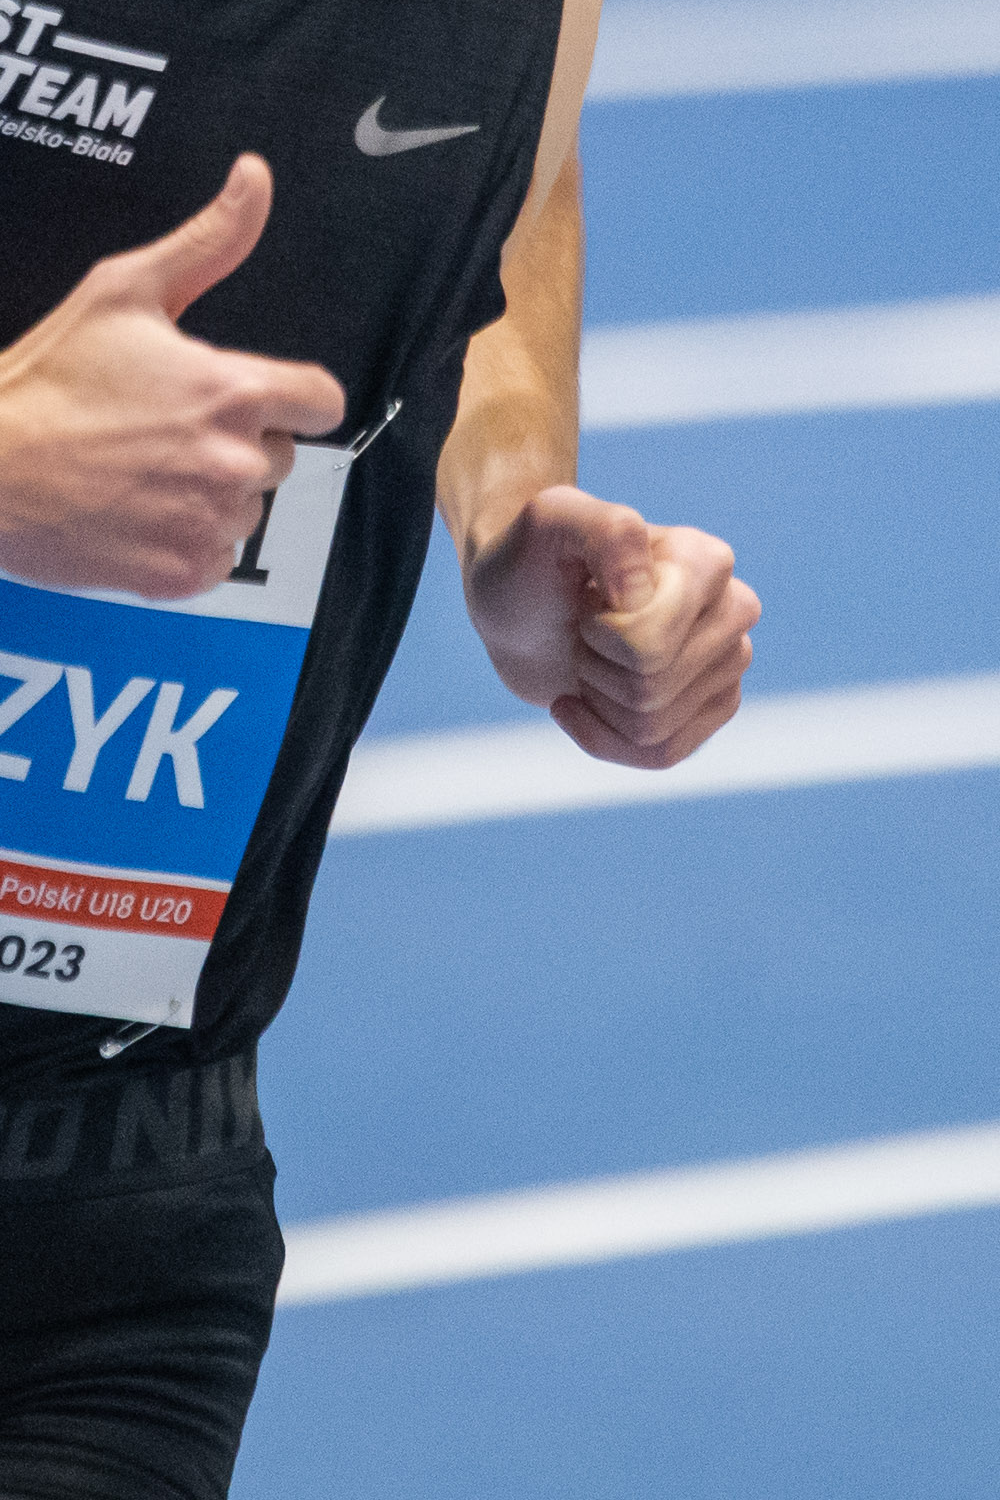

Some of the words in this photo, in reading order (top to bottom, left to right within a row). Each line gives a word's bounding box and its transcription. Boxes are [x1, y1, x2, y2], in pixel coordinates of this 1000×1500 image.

[0, 873, 86, 913] Polski
[88, 890, 136, 920] U18
[140, 896, 194, 926] U20
